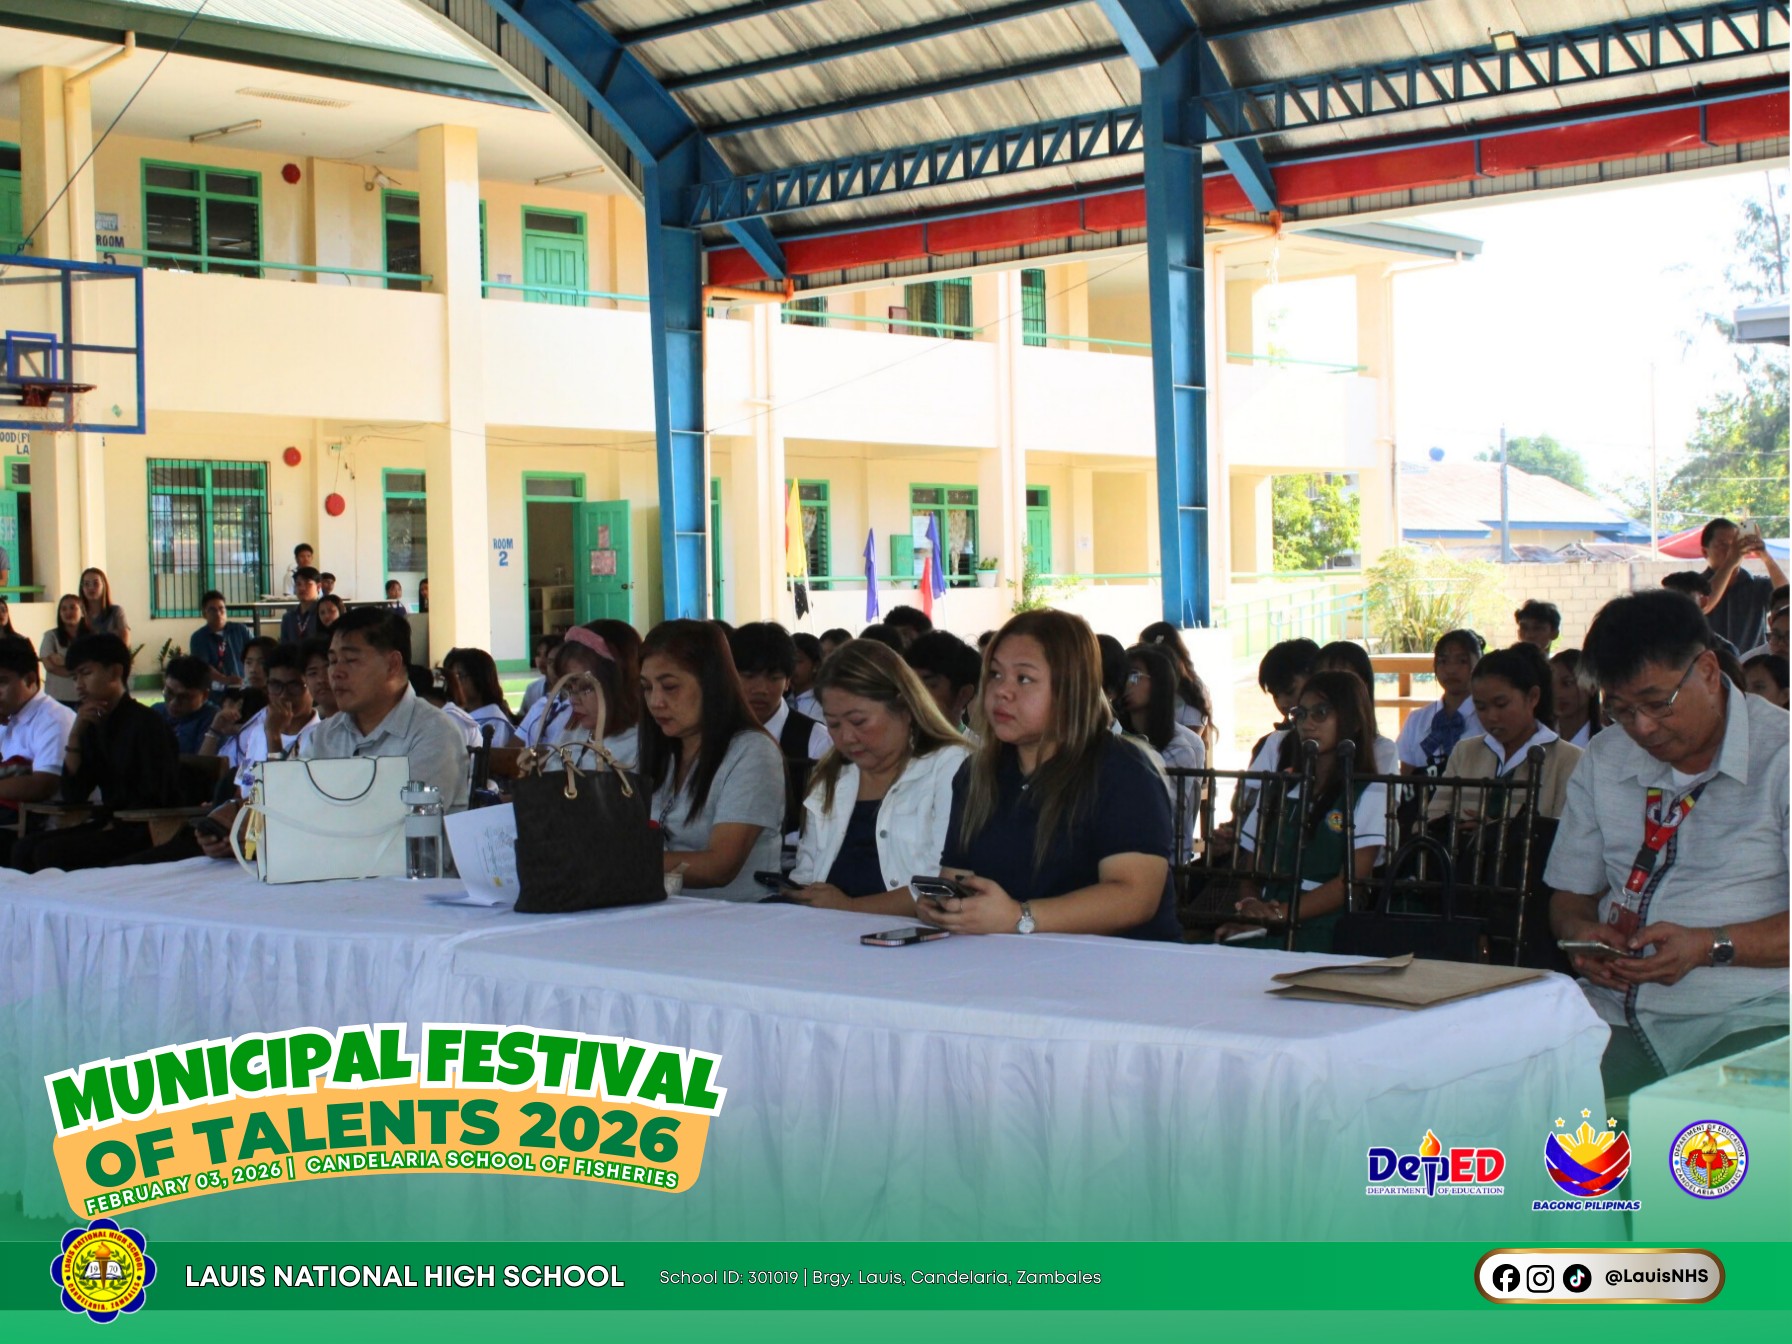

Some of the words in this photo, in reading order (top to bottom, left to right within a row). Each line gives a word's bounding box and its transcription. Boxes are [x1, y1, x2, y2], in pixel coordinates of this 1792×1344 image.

[96, 234, 125, 248] ROOM
[493, 538, 514, 549] ROOM
[498, 551, 508, 566] 2
